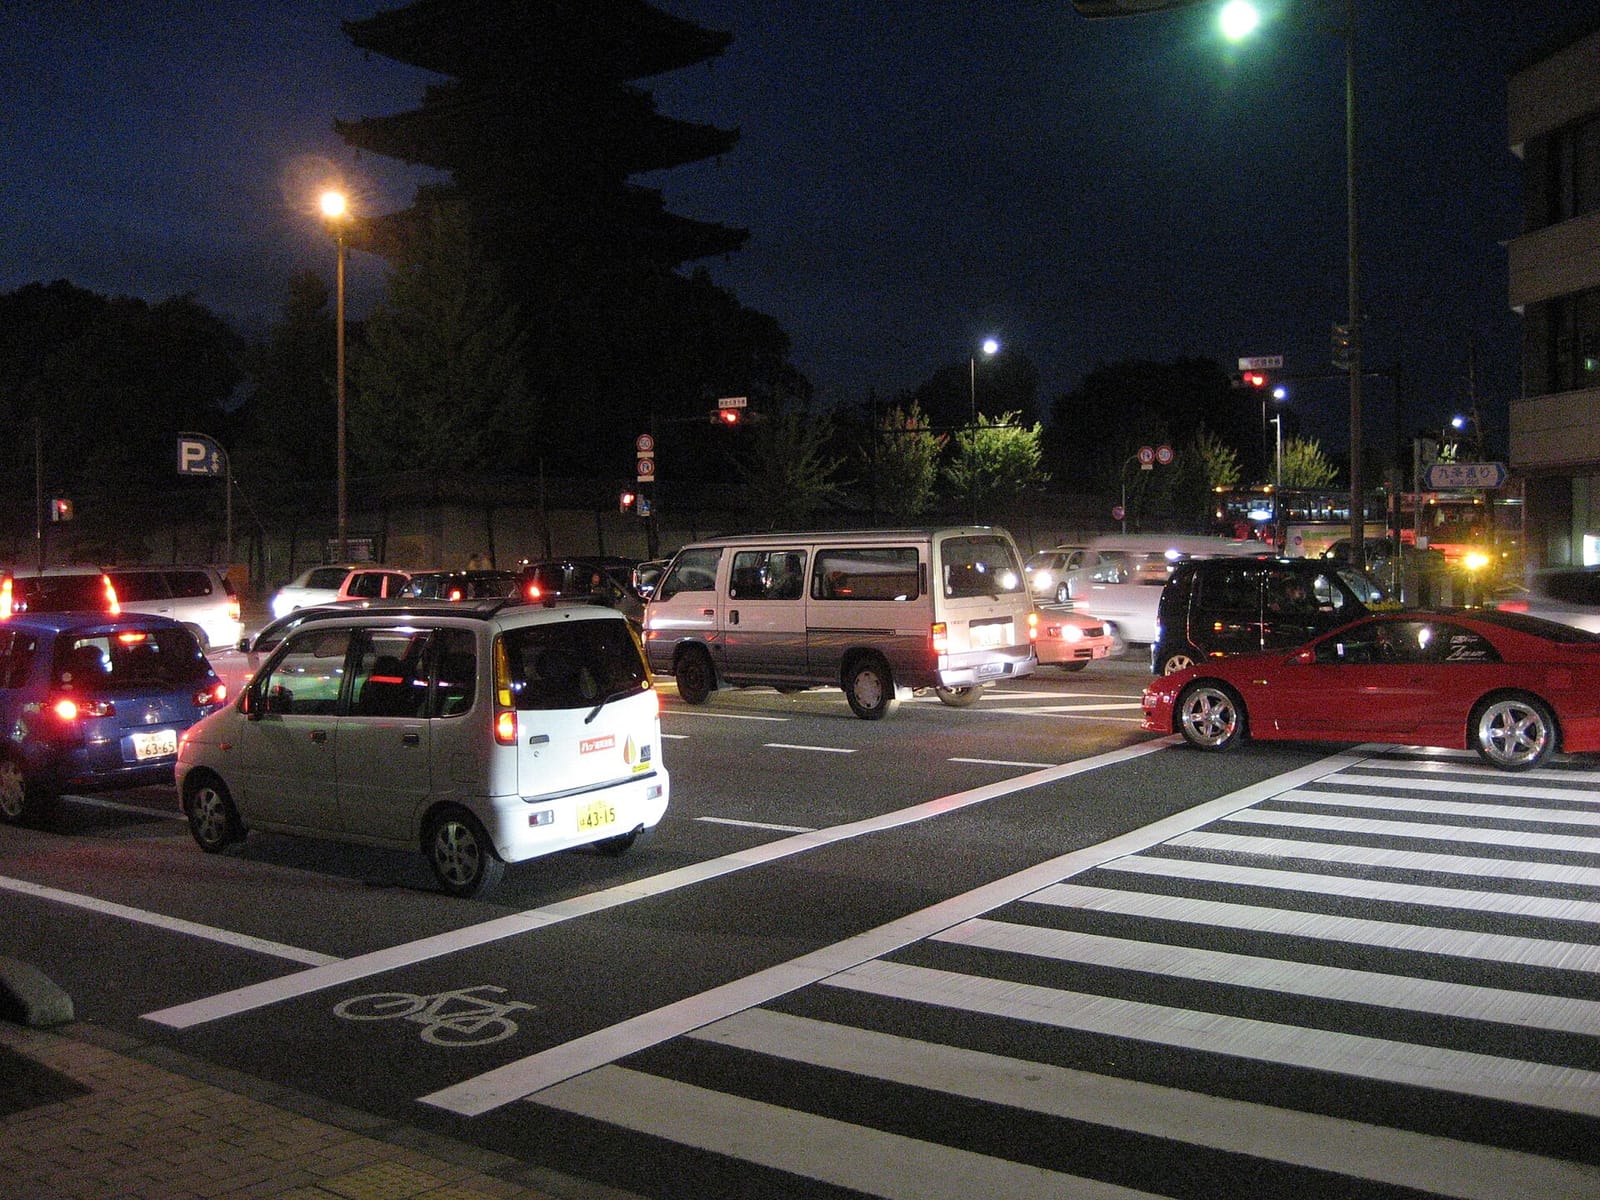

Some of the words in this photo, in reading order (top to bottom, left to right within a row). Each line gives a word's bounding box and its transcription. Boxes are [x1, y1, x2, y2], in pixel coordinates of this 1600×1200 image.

[181, 441, 206, 471] P
[1438, 466, 1490, 479] 九条通り
[586, 807, 616, 828] 43-15
